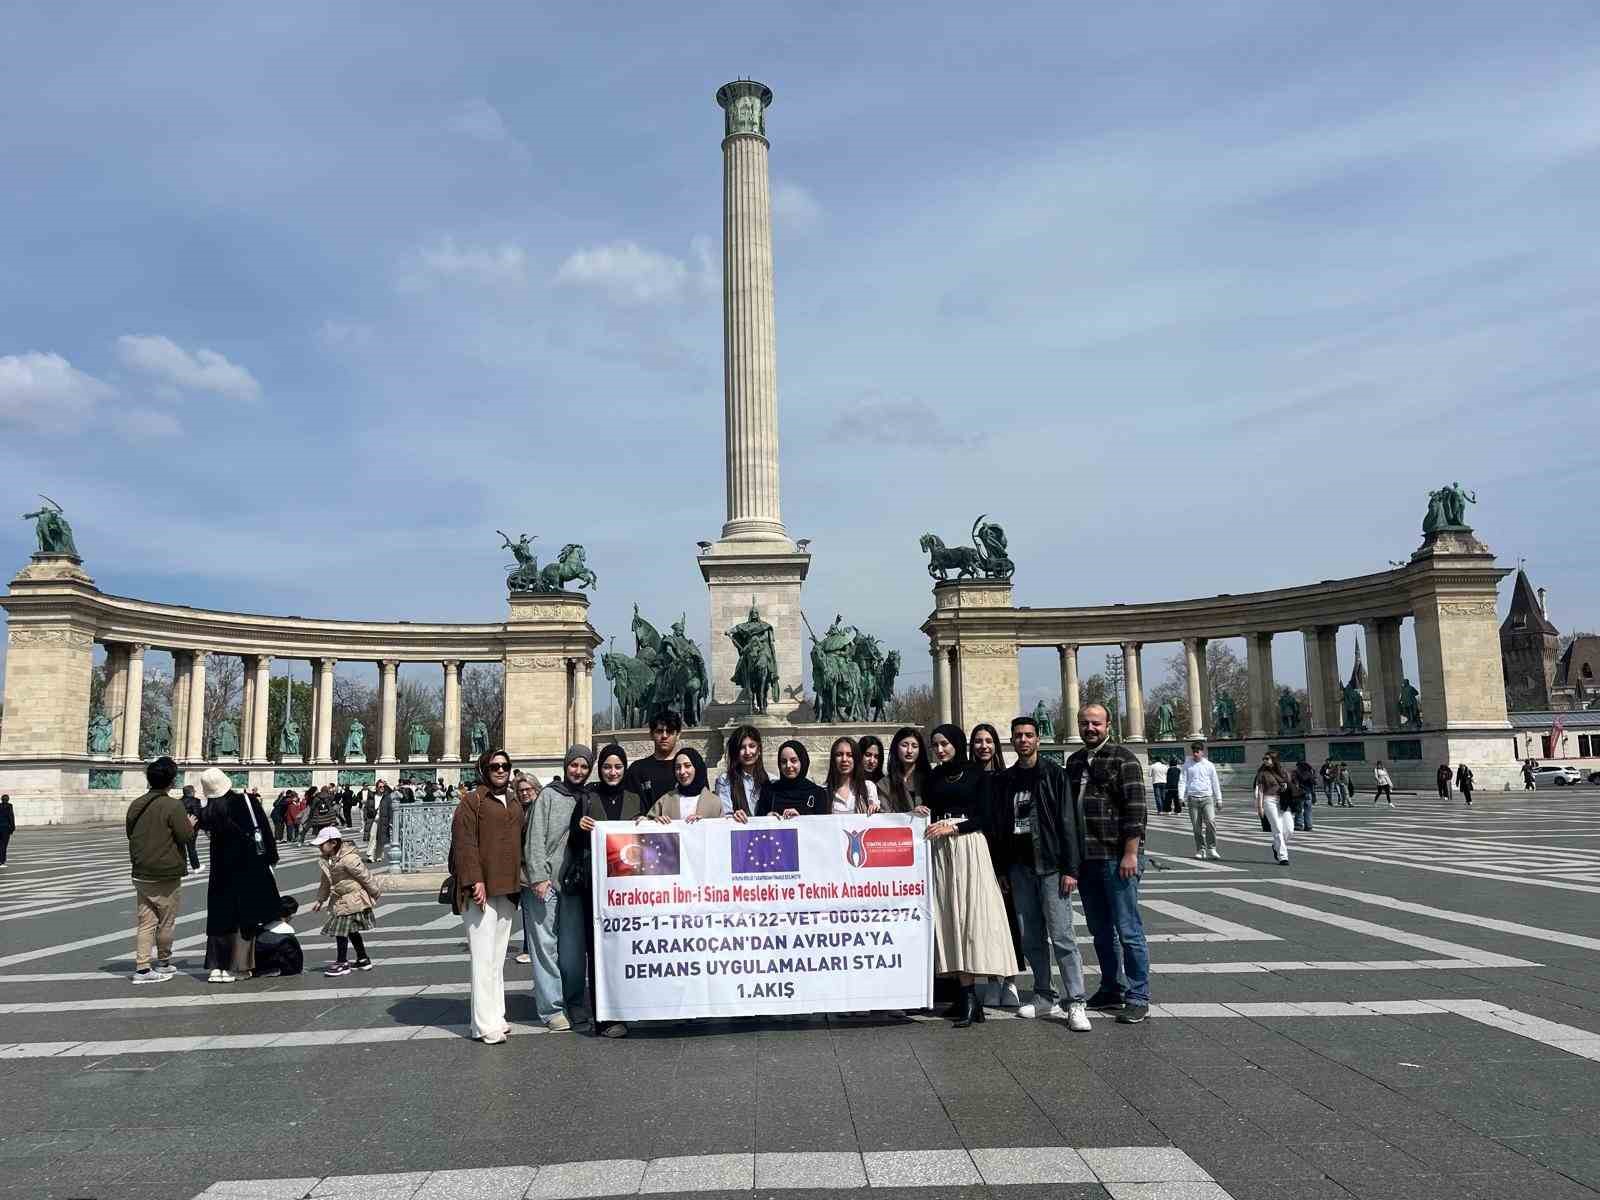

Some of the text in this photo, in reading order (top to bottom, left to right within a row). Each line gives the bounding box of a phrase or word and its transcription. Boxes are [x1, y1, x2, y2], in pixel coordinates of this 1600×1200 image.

[607, 880, 925, 907] Karakoçan İbn-i Sina Mesleki ve Teknik Anadolu Lisesi
[631, 931, 894, 955] KARAKOÇAN'DAN AVRUPA'YA
[625, 953, 902, 979] DEMANS UYGULAMALARI STAJI
[736, 981, 795, 998] 1.AKIŞ
